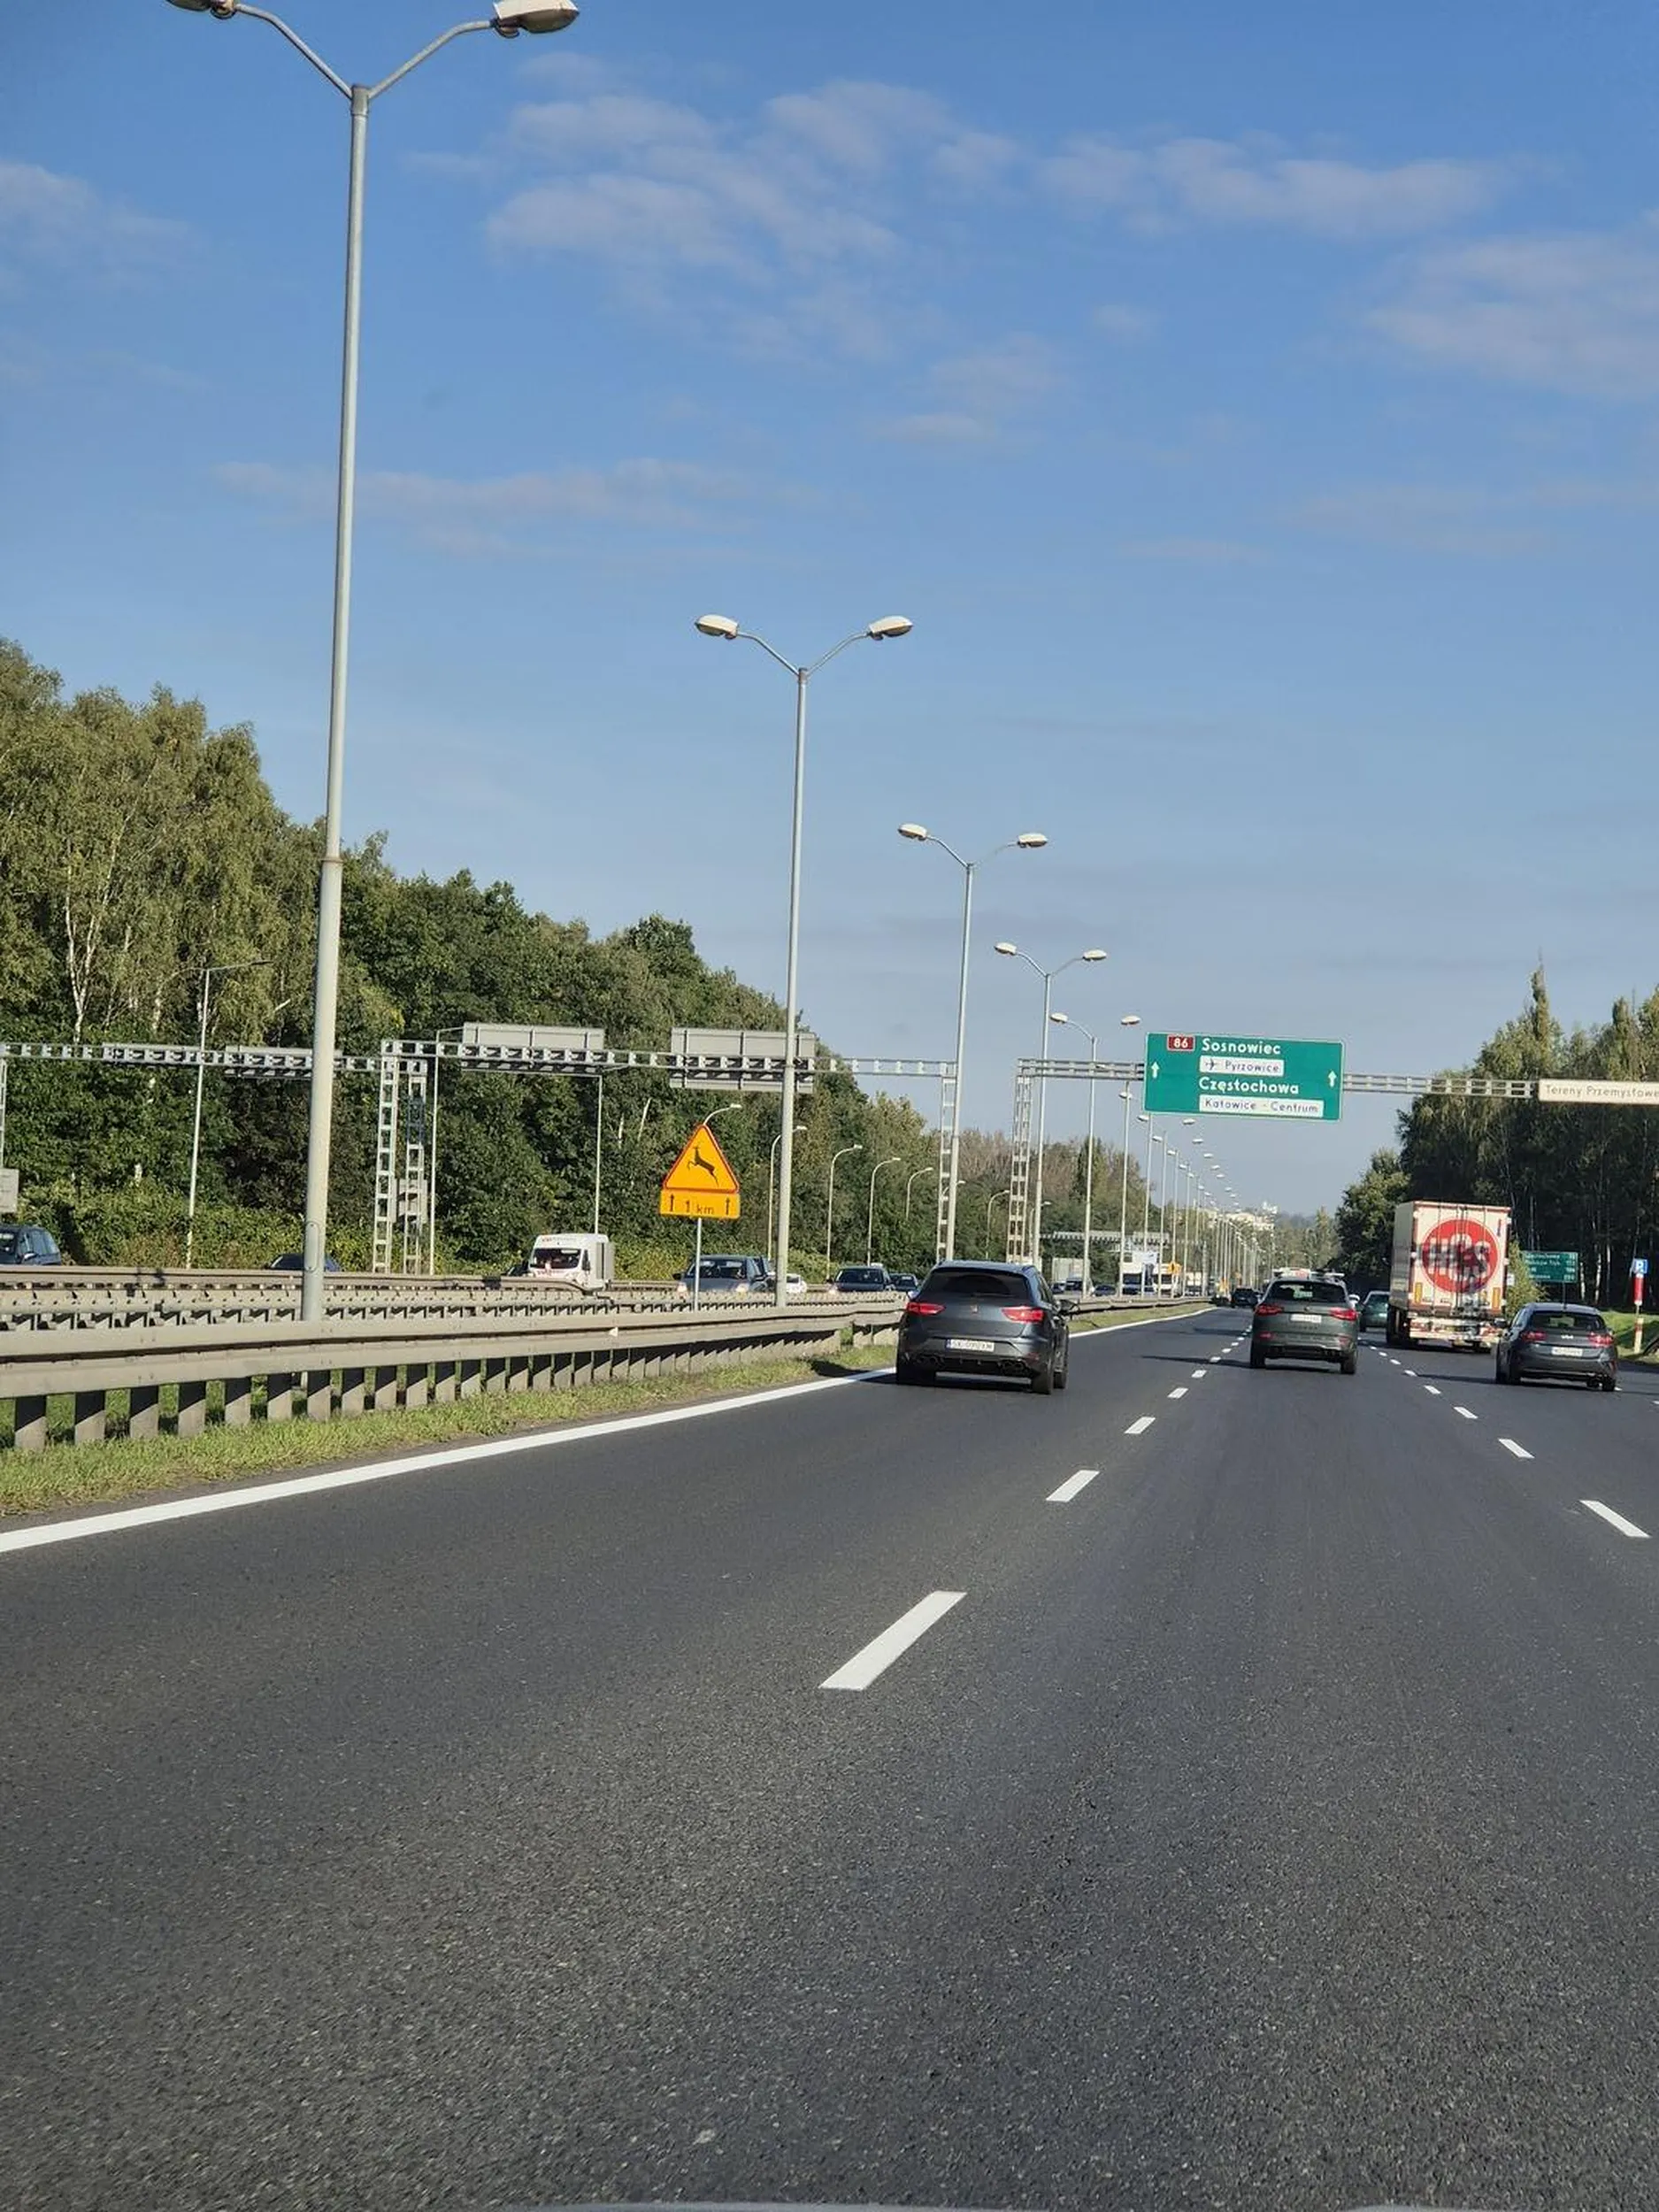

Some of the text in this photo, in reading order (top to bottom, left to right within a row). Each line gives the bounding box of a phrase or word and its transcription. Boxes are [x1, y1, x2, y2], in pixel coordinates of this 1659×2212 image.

[1173, 1037, 1189, 1048] 86
[1202, 1038, 1281, 1055] Sosnowiec
[1225, 1061, 1280, 1073] Pyrzowice
[1198, 1077, 1300, 1094] Częstochowa
[1546, 1085, 1582, 1098] Tereny
[1204, 1099, 1256, 1110] Katowice
[1271, 1102, 1318, 1112] Centrum
[686, 1200, 715, 1215] 1 km
